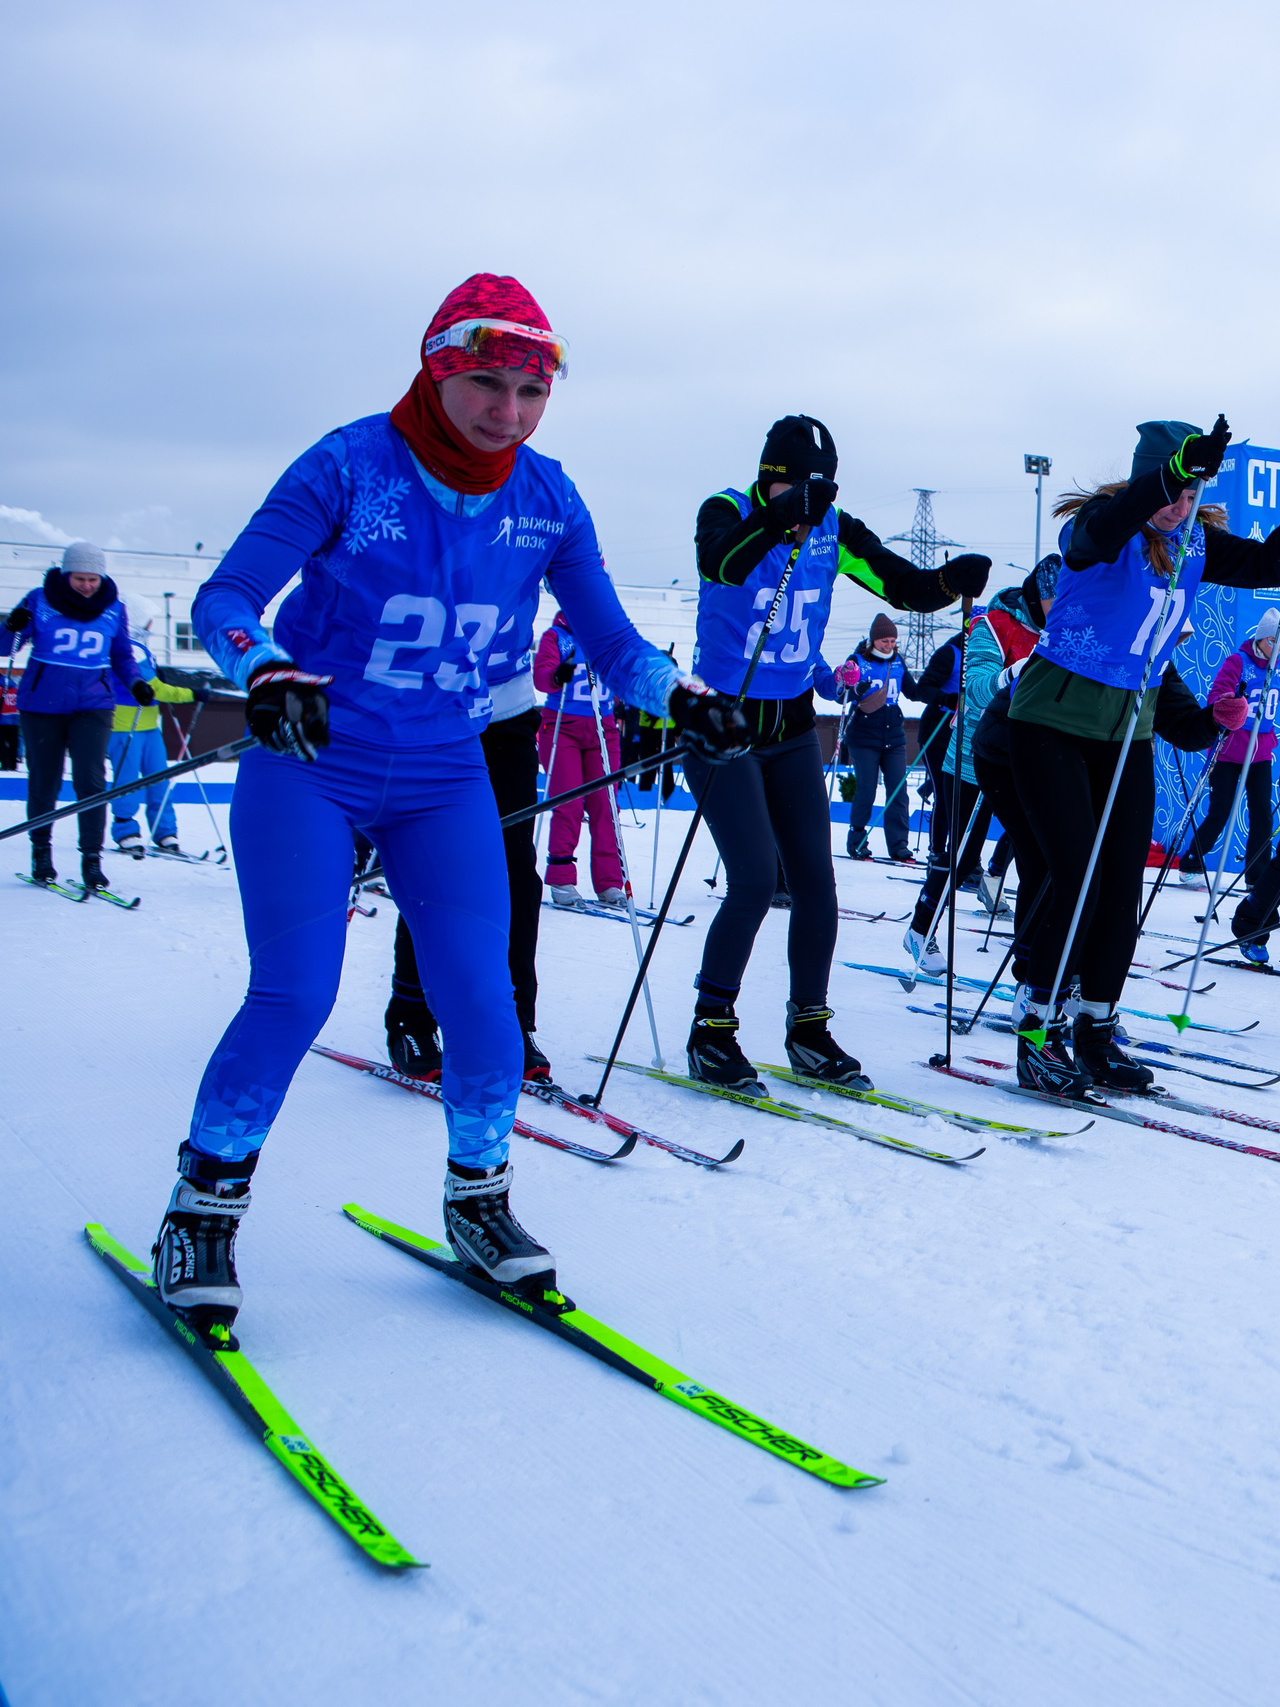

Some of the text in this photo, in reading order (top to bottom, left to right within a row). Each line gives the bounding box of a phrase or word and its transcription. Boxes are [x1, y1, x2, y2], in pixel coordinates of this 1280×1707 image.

[760, 464, 787, 473] SPINE
[517, 516, 564, 535] ЛЫЖНЯ
[765, 564, 793, 629] NORDWAY
[744, 588, 820, 664] 25
[53, 628, 104, 659] 22
[363, 594, 499, 692] 23
[1247, 689, 1279, 720] 20
[1027, 1055, 1063, 1085] SPINE
[722, 1090, 755, 1105] FISCHER
[827, 1085, 862, 1099] FISCHER
[450, 1207, 484, 1235] SUPER
[178, 1227, 196, 1279] MADSHUS
[500, 1290, 533, 1314] FISCHER
[174, 1319, 196, 1346] FISCHER
[690, 1394, 823, 1462] FISCHER
[290, 1451, 386, 1536] FISCHER
